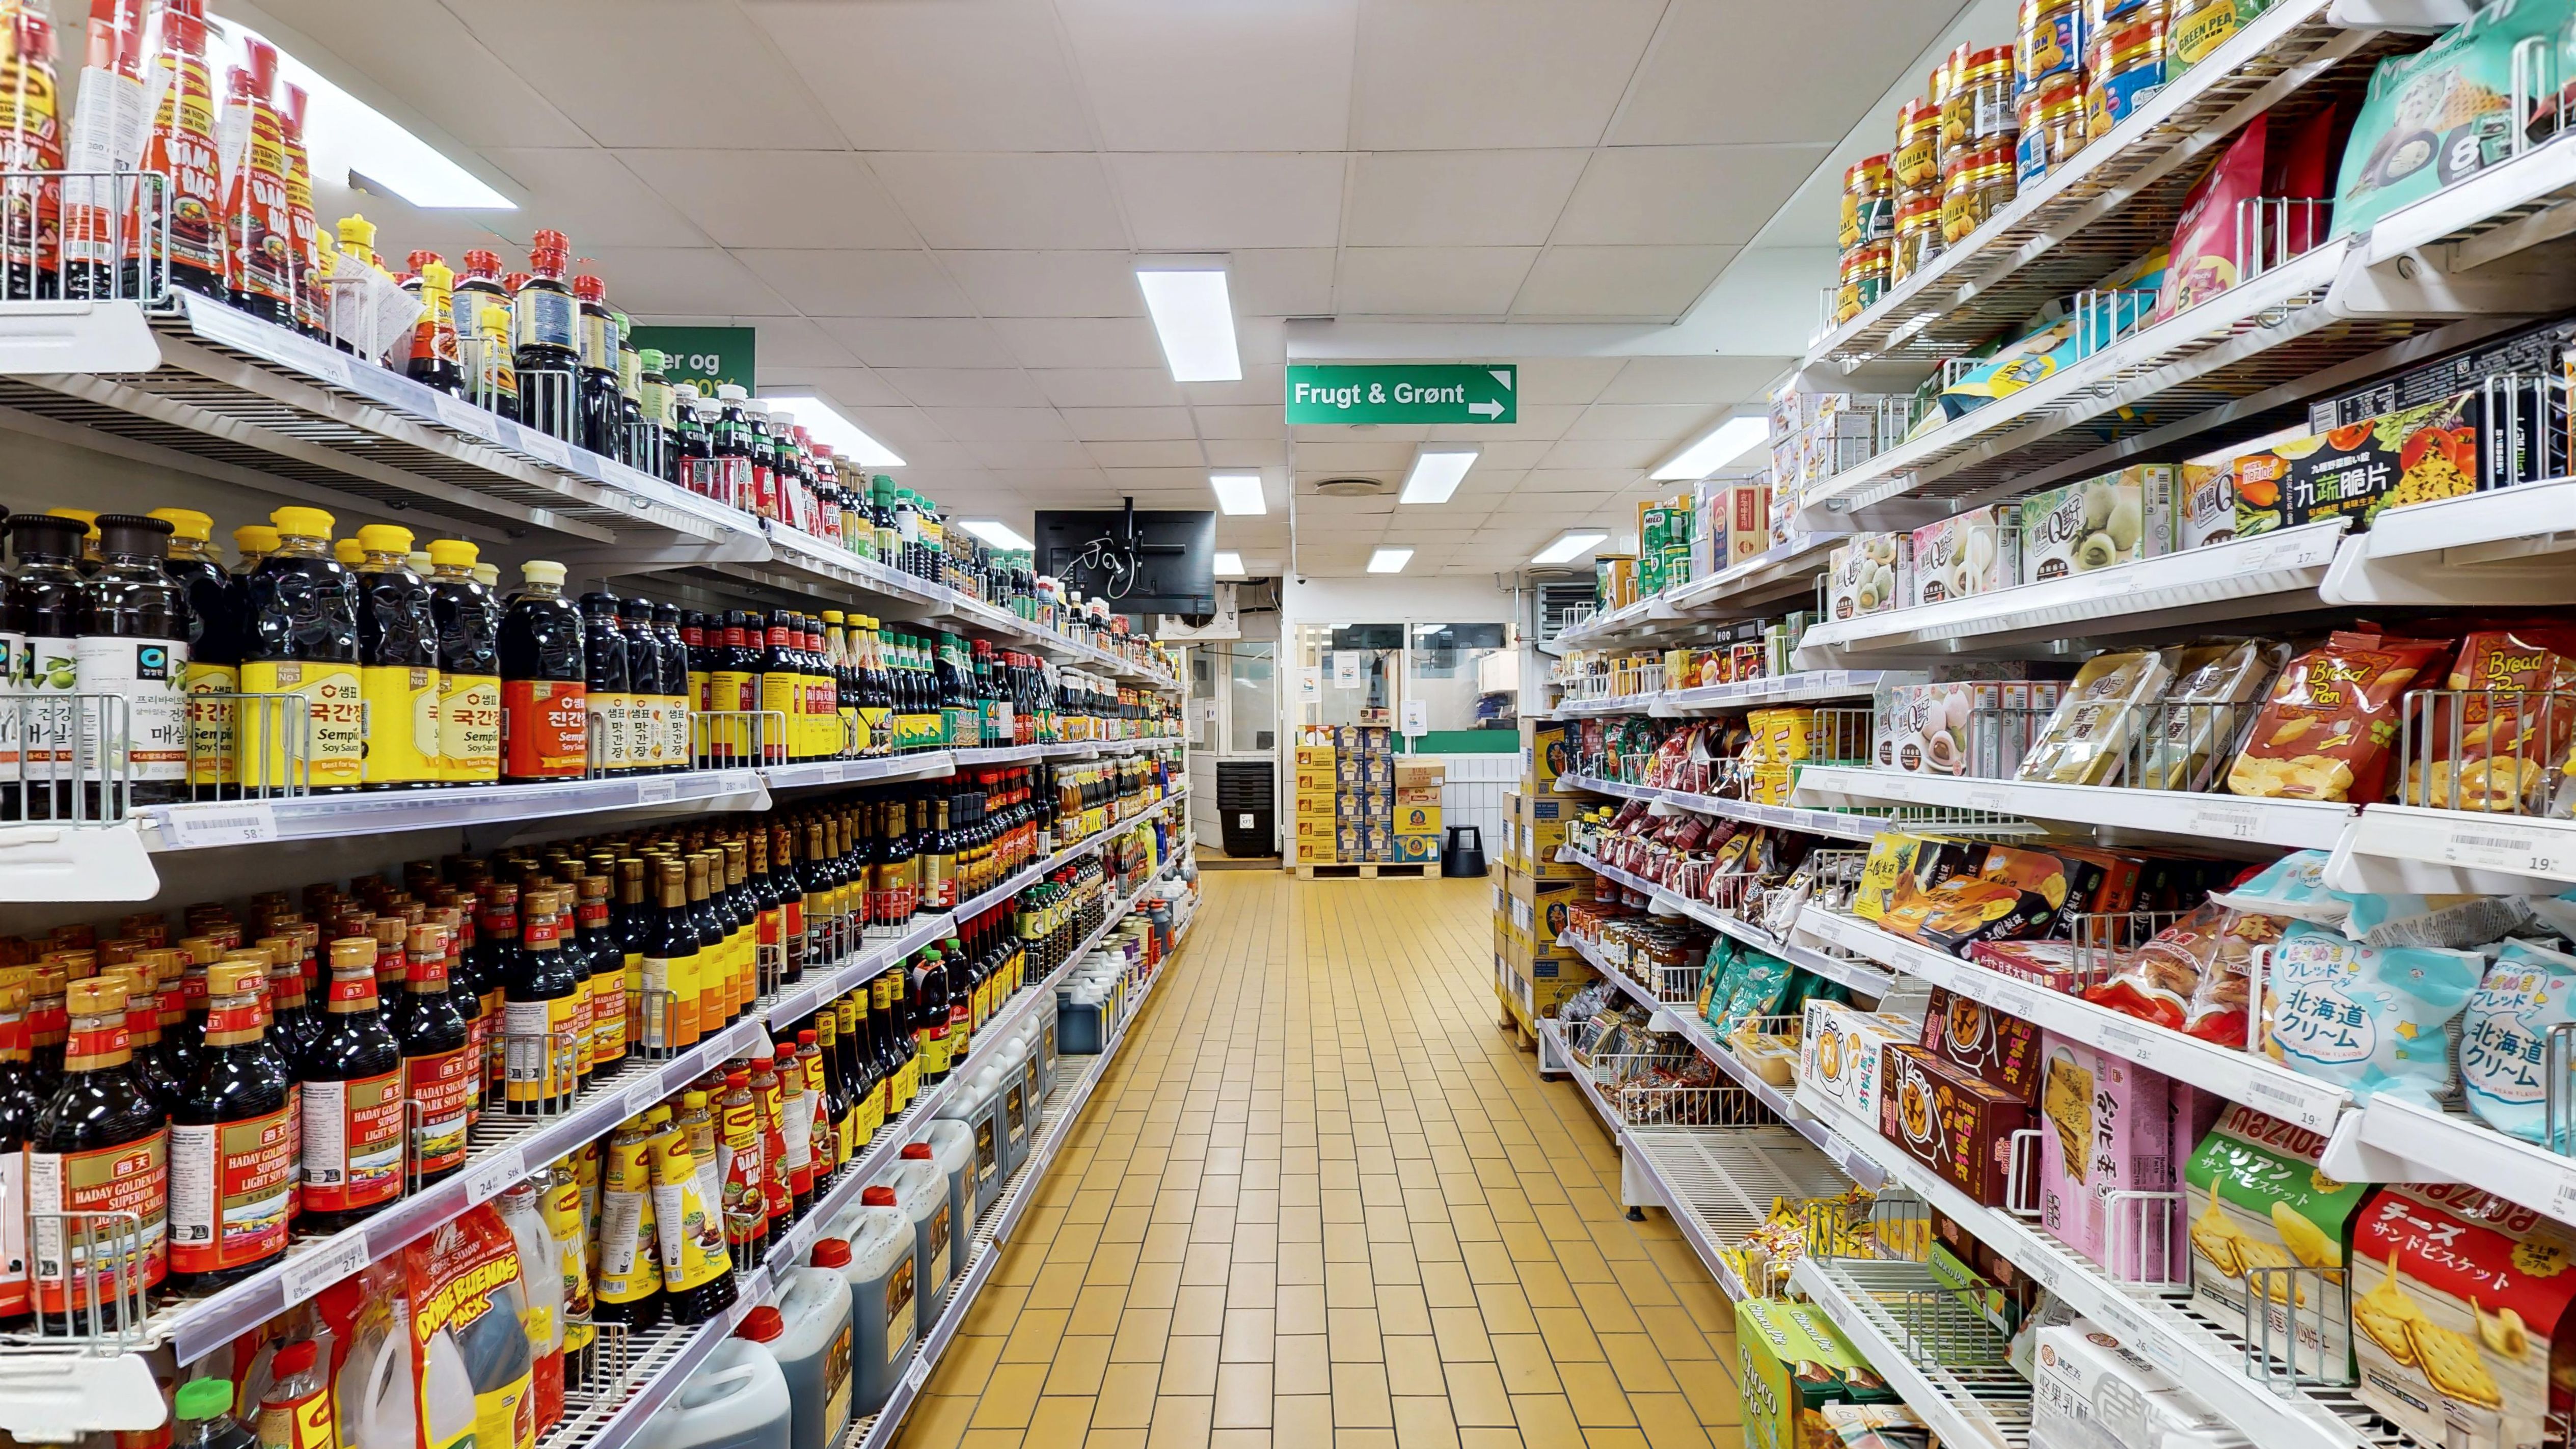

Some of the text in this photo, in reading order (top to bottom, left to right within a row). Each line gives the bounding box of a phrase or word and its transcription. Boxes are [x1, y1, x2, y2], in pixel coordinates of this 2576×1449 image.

[2179, 12, 2233, 49] GREEN PEA
[1899, 149, 1928, 168] DURIAN
[2450, 135, 2480, 171] 8
[690, 354, 719, 376] og
[1295, 383, 1465, 409] Frugt & Grønt
[1645, 516, 1662, 525] MILO
[2297, 553, 2312, 563] 17
[2309, 661, 2371, 683] Bread
[2488, 650, 2545, 678] Bread
[278, 673, 301, 681] No.1
[339, 686, 357, 698] 샘표
[482, 695, 497, 705] 샘표
[2311, 683, 2340, 704] Pan
[608, 708, 625, 719] 샘표
[631, 708, 650, 719] 샘표
[669, 709, 684, 719] 샘표
[611, 721, 624, 758] 맛간장
[634, 721, 649, 757] 맛간장
[672, 722, 684, 756] 맛간장
[322, 744, 339, 753] Soy
[468, 744, 481, 753] Soy
[562, 744, 574, 752] Soy
[243, 829, 258, 839] 58
[2233, 824, 2247, 836] 11
[2529, 857, 2550, 870] 19
[595, 994, 615, 1004] HADAY
[1971, 988, 1981, 998] 25
[2018, 1005, 2028, 1016] 25
[2286, 989, 2366, 1029] 北海道
[2471, 1020, 2546, 1065] 北海道
[2136, 1049, 2147, 1059] 23
[416, 1084, 446, 1100] HADAY
[421, 1098, 443, 1112] DARK
[355, 1108, 381, 1123] HADAY
[2301, 1112, 2315, 1125] 19
[365, 1126, 387, 1142] LIGHT
[229, 1152, 261, 1169] HADAY
[2209, 1140, 2293, 1180] ドリアン
[75, 1176, 152, 1205] HADAY GOLDEN
[242, 1173, 269, 1191] LIGHT
[479, 1168, 520, 1196] 24 Stk
[109, 1186, 154, 1211] SUPERIOR
[2380, 1201, 2466, 1246] チーズ
[261, 1237, 276, 1251] 500
[342, 1256, 356, 1272] 27
[2372, 1222, 2509, 1291] サンドビスケット
[1932, 1250, 1968, 1288] Choco Pie
[452, 1254, 519, 1305] BUENAS
[2042, 1272, 2053, 1287] 26
[451, 1294, 490, 1330] PACK
[1746, 1302, 1787, 1345] Choco Pie
[1789, 1310, 1834, 1352] Choco Pie
[2136, 1338, 2146, 1352] 26
[1740, 1343, 1778, 1415] Choco
[1743, 1374, 1761, 1419] Pie
